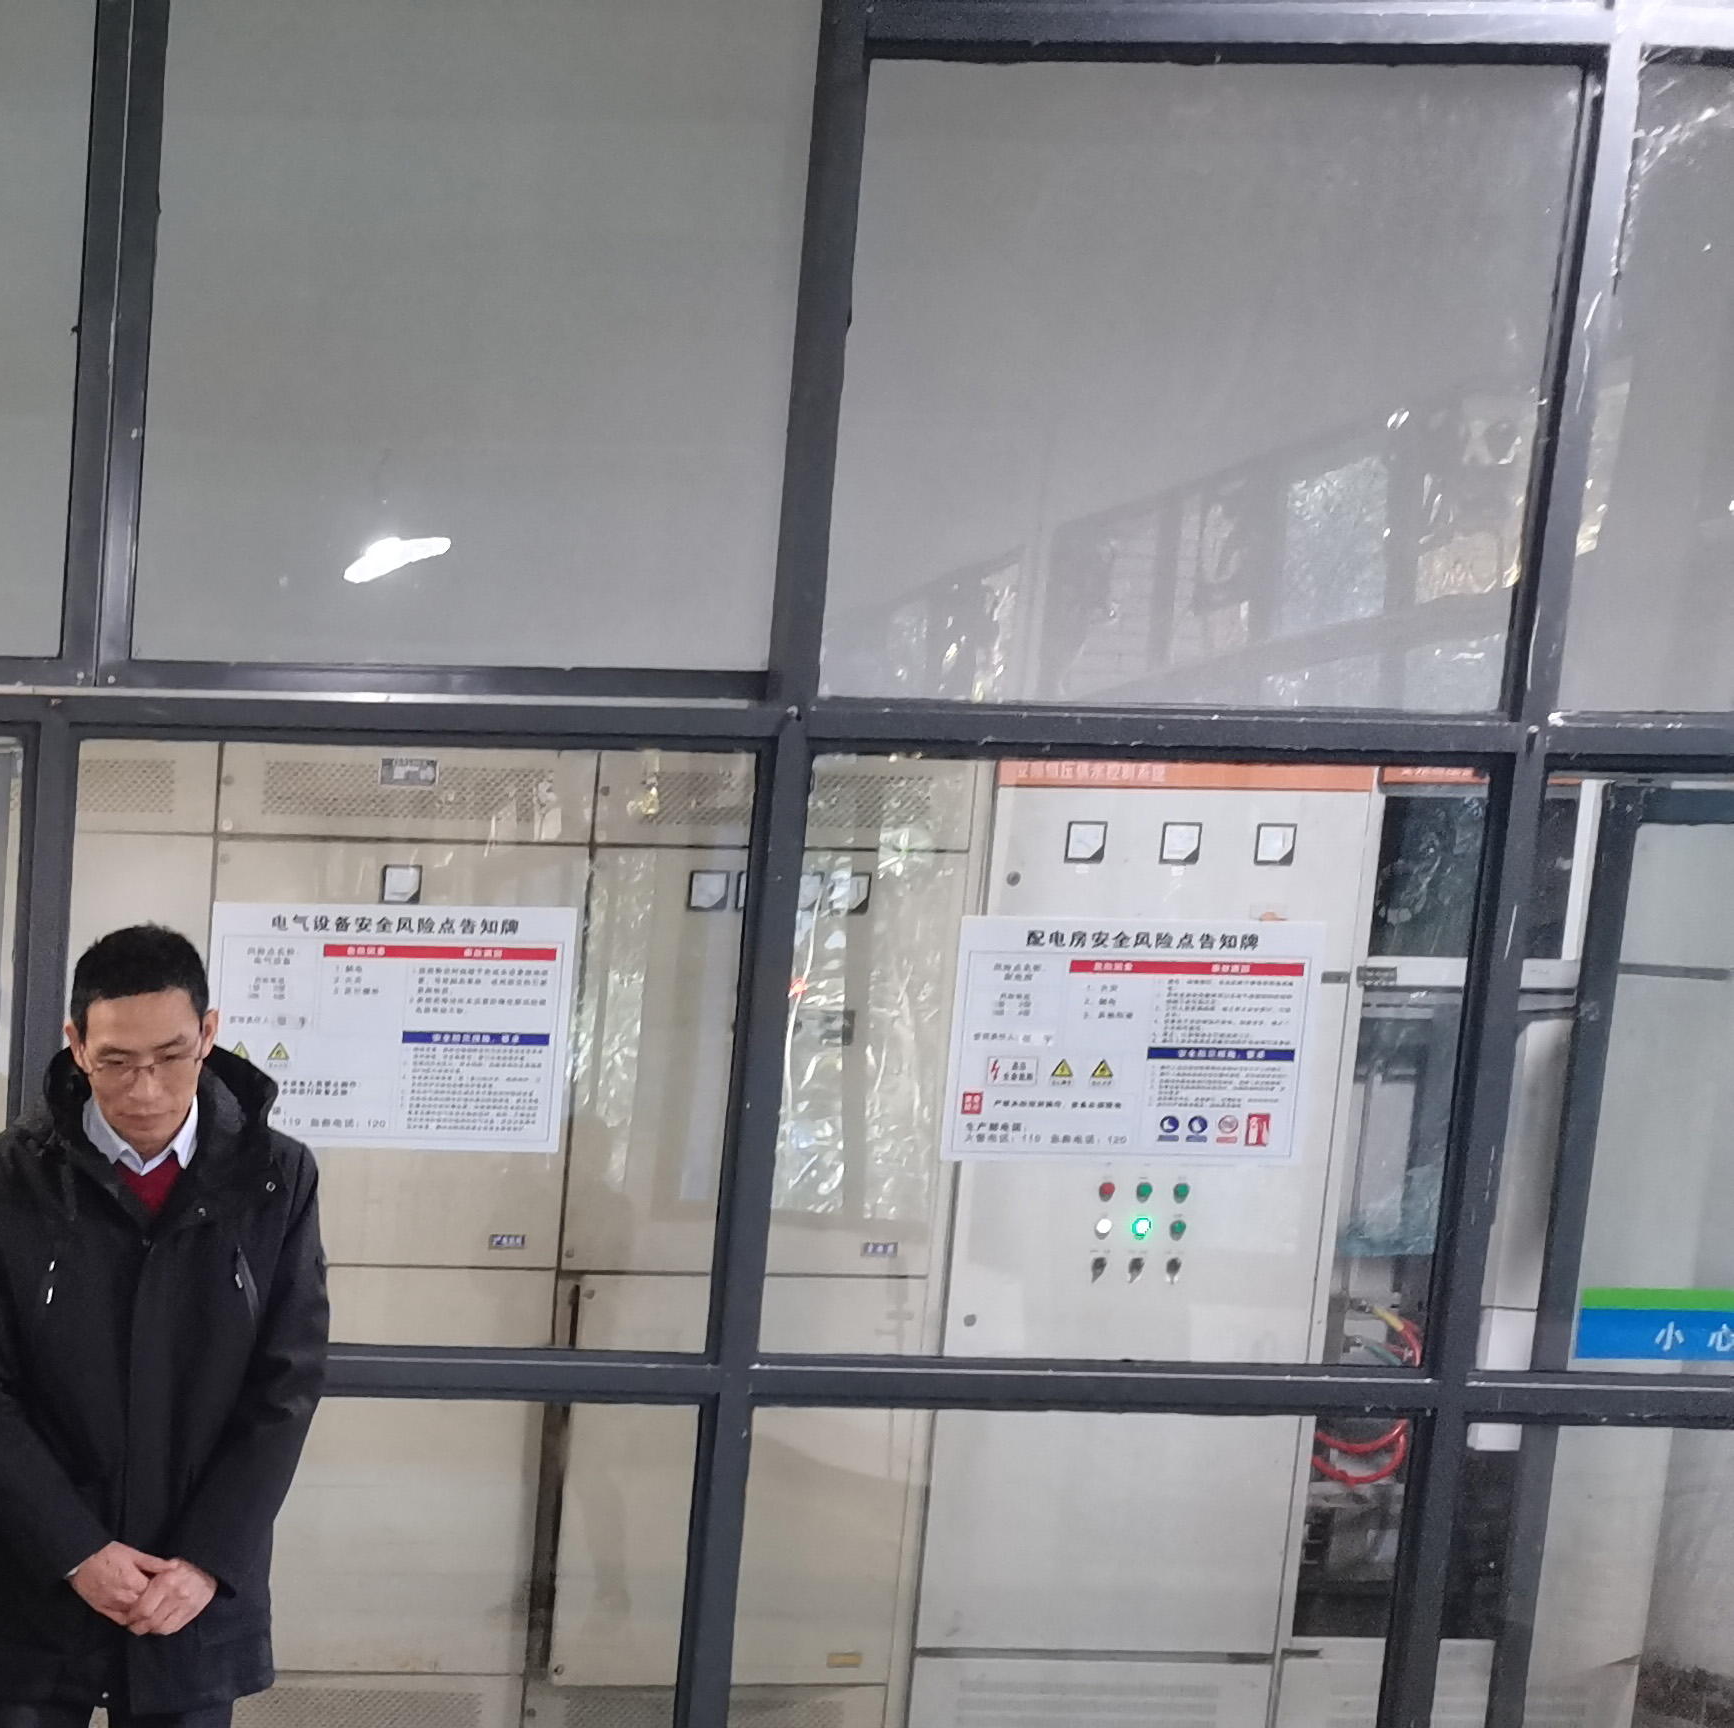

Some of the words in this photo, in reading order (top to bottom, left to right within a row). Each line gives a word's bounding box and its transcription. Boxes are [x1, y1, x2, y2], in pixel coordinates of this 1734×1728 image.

[271, 913, 520, 936] 电气设备安全风险点告知牌
[1025, 929, 1260, 951] 配电房安全风险点告知牌
